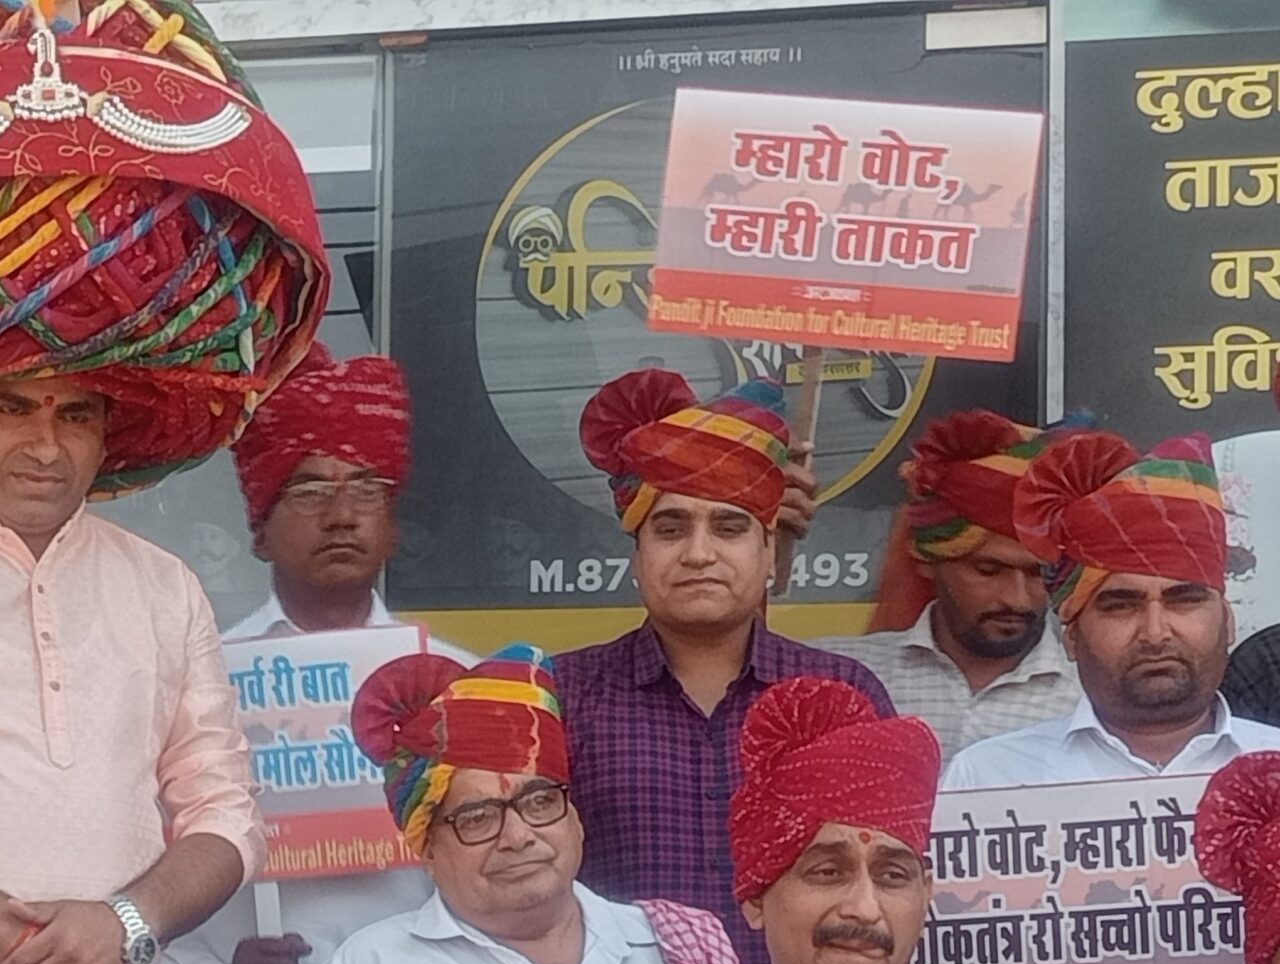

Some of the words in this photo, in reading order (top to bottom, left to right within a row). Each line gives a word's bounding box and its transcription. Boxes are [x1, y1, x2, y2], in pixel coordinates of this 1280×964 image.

[657, 45, 703, 73] हनुमते
[705, 50, 736, 67] सदा
[739, 48, 780, 67] सहाय
[1135, 64, 1280, 133] दुल्ह
[733, 125, 848, 182] म्हारो
[861, 129, 959, 200] वोट,
[709, 201, 821, 257] म्हारी
[836, 218, 976, 269] ताकत
[717, 300, 804, 334] Foundation
[806, 306, 831, 336] for
[832, 309, 895, 341] Cultural
[898, 315, 967, 350] Heritage
[970, 320, 1011, 349] Trust
[1154, 325, 1280, 410] सुवि
[269, 656, 296, 706] री
[298, 662, 350, 703] बात
[263, 840, 320, 874] ultural
[324, 836, 394, 870] Heritage
[1061, 800, 1147, 870] म्हारो
[1151, 797, 1197, 865] फै
[1030, 896, 1064, 961] रो
[1069, 890, 1152, 960] सच्चो
[1156, 887, 1246, 952] परिच
